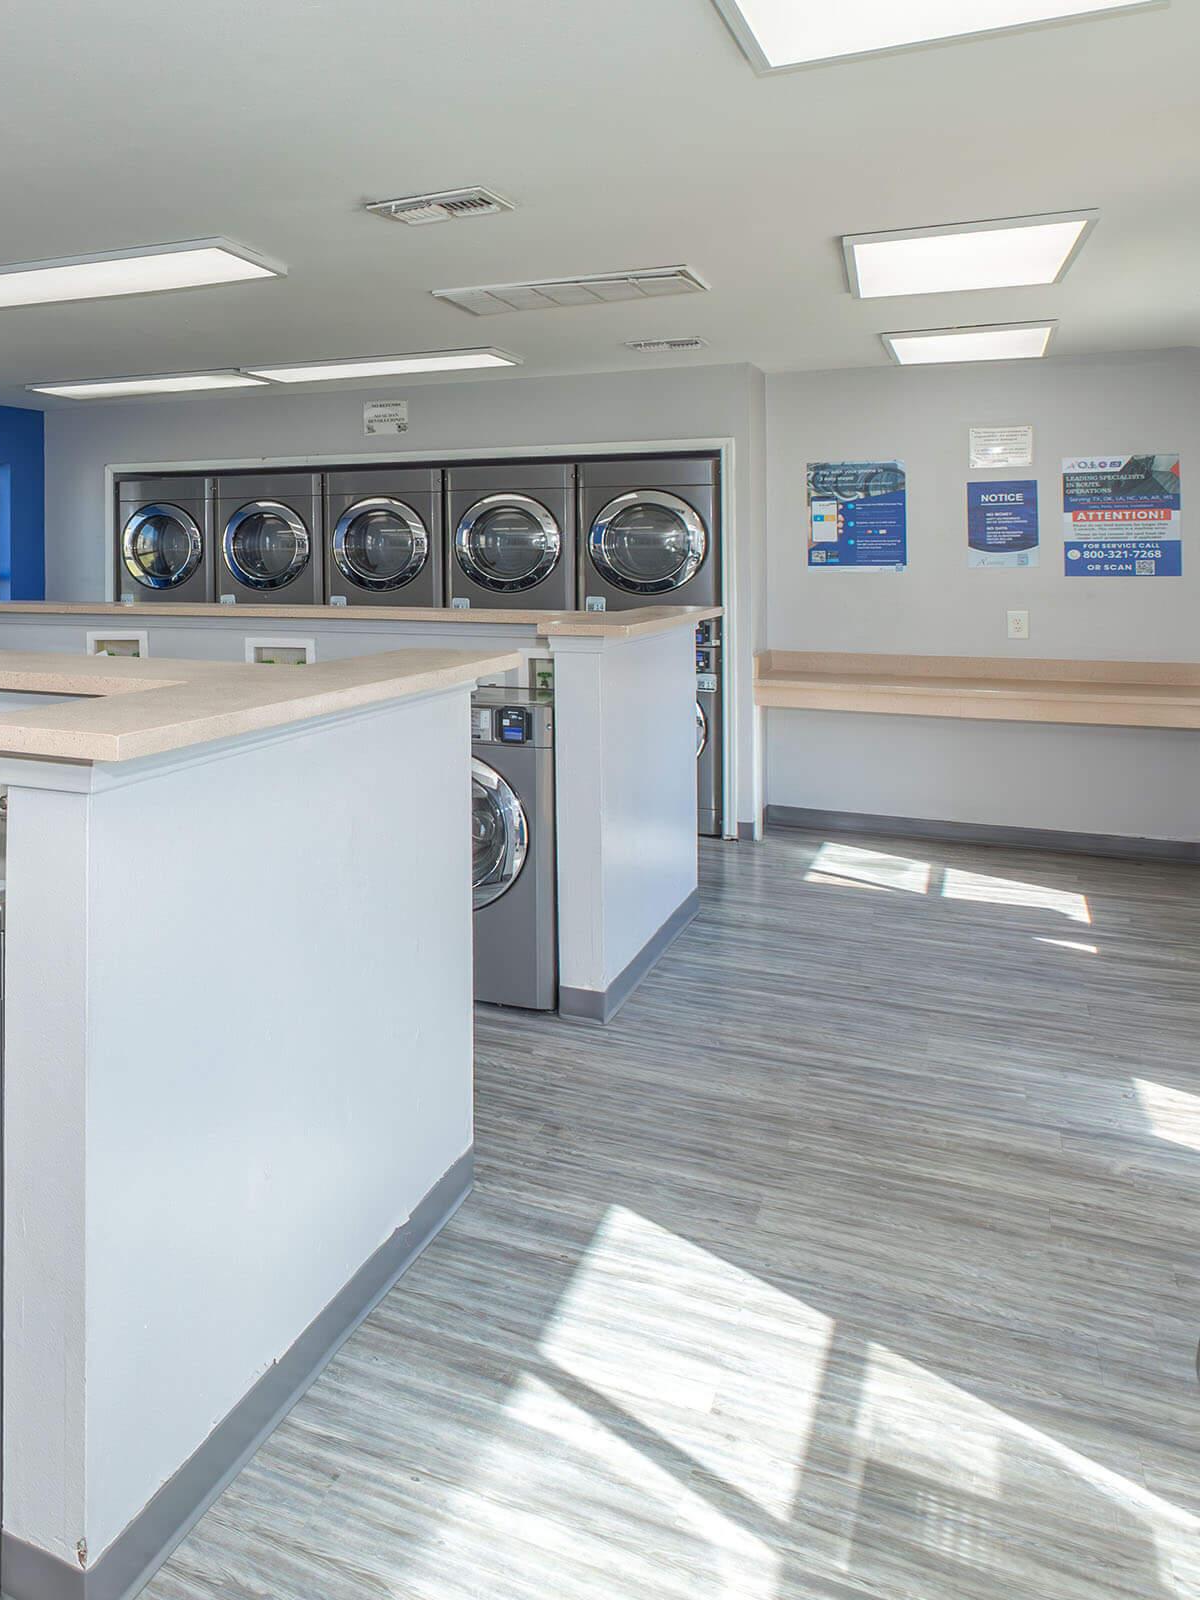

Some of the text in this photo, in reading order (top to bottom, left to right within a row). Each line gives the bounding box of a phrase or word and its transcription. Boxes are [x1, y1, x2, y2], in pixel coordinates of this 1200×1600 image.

[980, 493, 1024, 502] NOTICE
[1076, 510, 1165, 520] ATTENTION!
[1082, 549, 1162, 559] 800-321-7268
